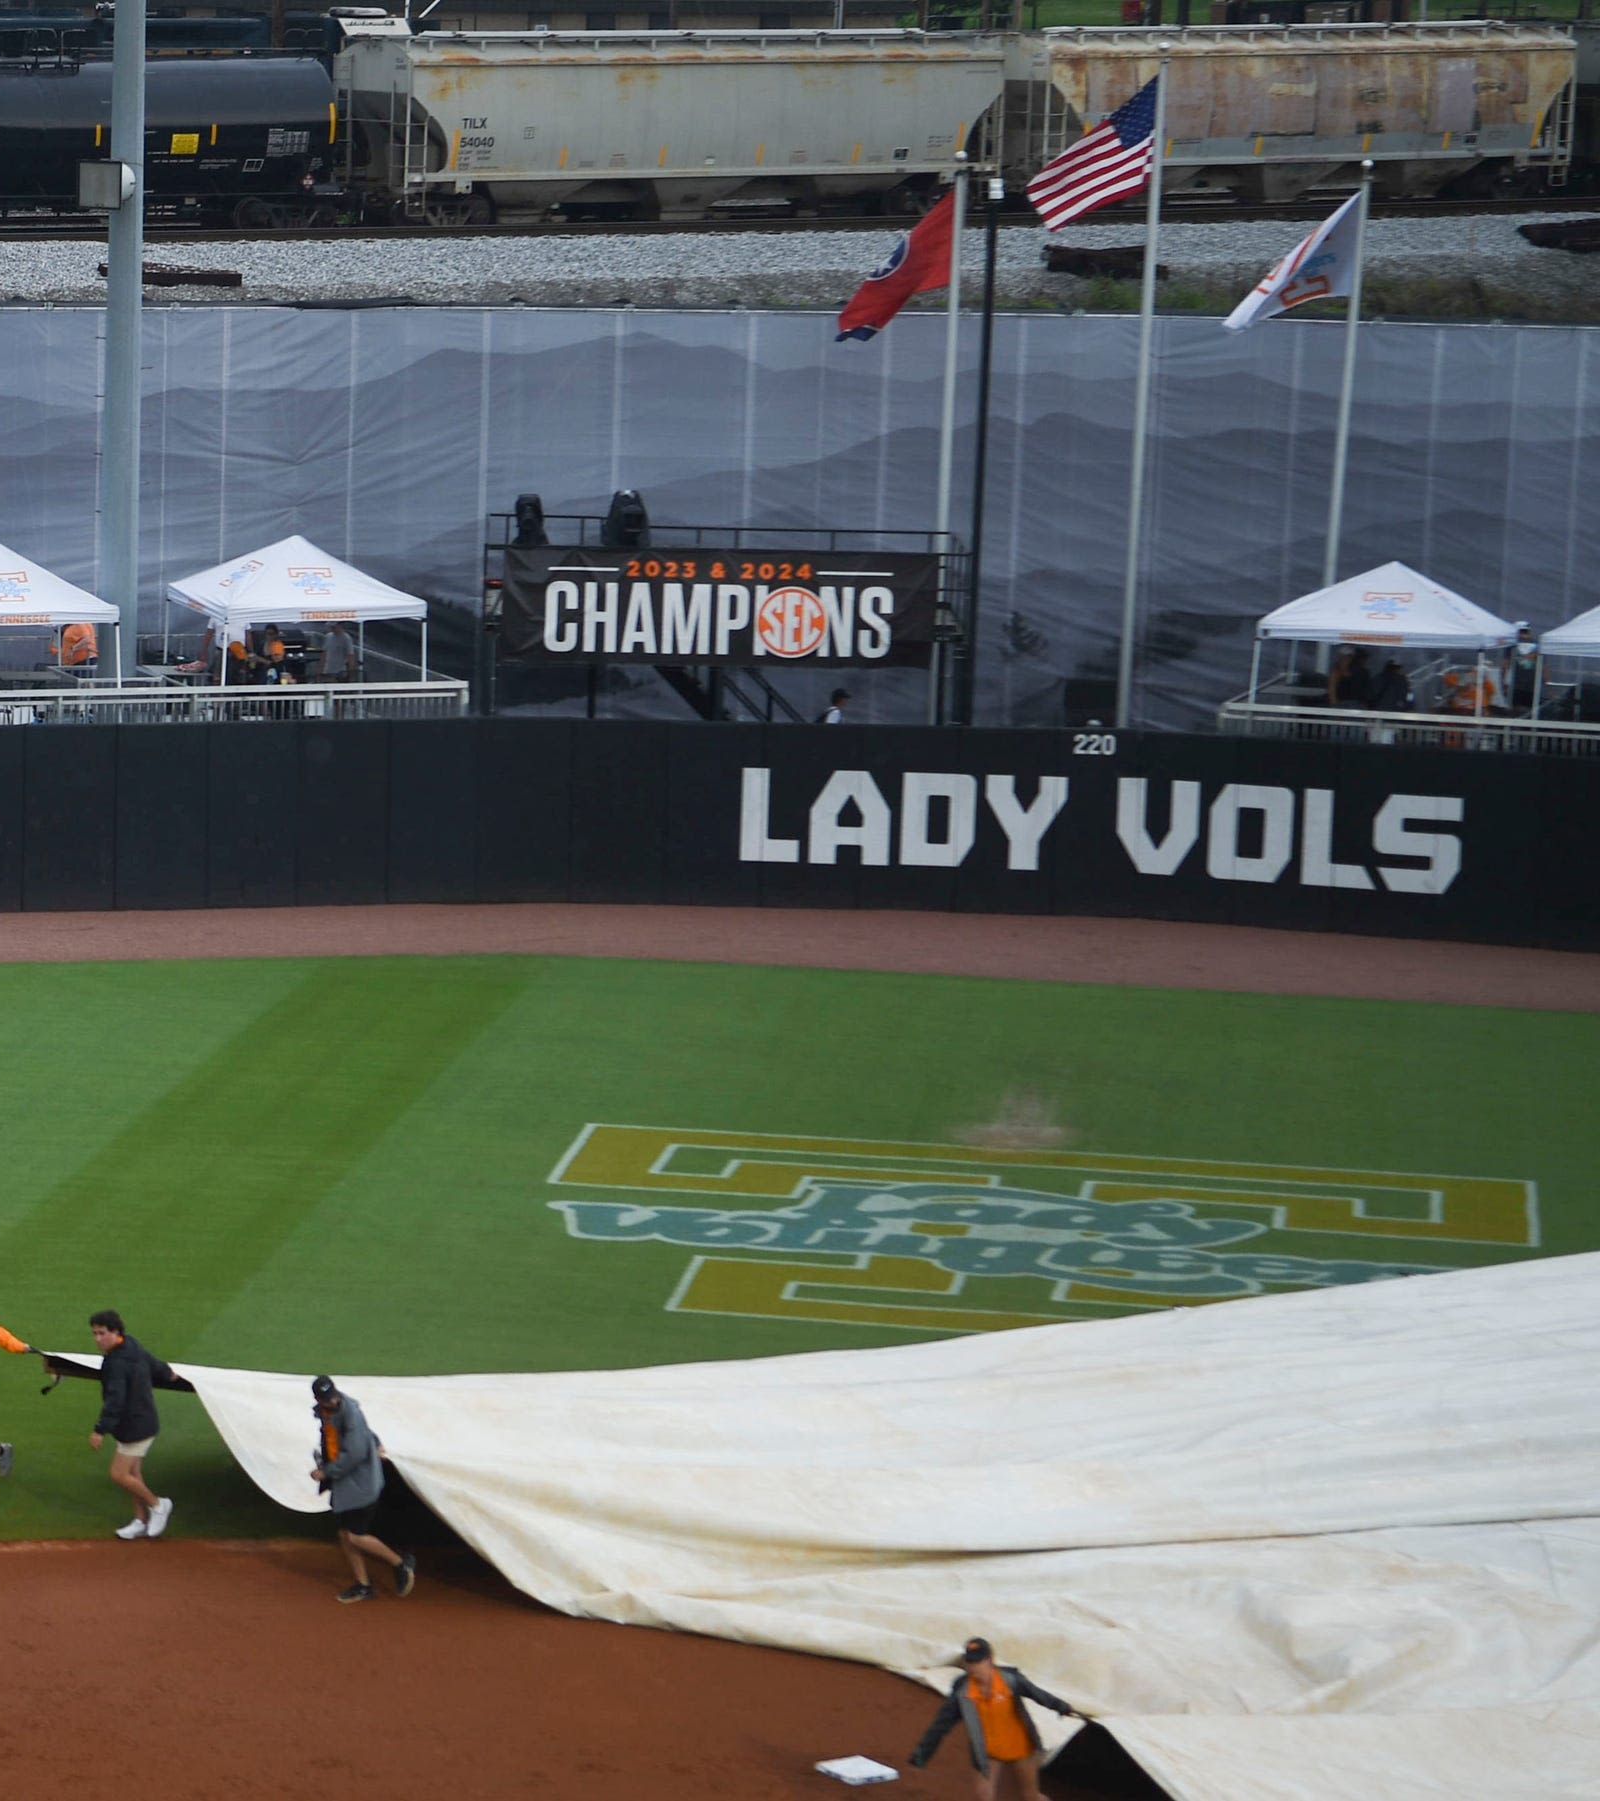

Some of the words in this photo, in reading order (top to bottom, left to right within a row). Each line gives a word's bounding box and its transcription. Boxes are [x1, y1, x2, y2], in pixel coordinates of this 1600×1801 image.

[462, 117, 488, 129] TILX
[460, 136, 495, 148] 54040
[626, 560, 697, 578] 2023
[709, 562, 726, 579] &
[740, 562, 813, 580] 2024
[761, 591, 824, 653] SEC
[1073, 734, 1116, 755] 220
[738, 766, 1069, 871] LADY
[1116, 776, 1464, 895] VOLS
